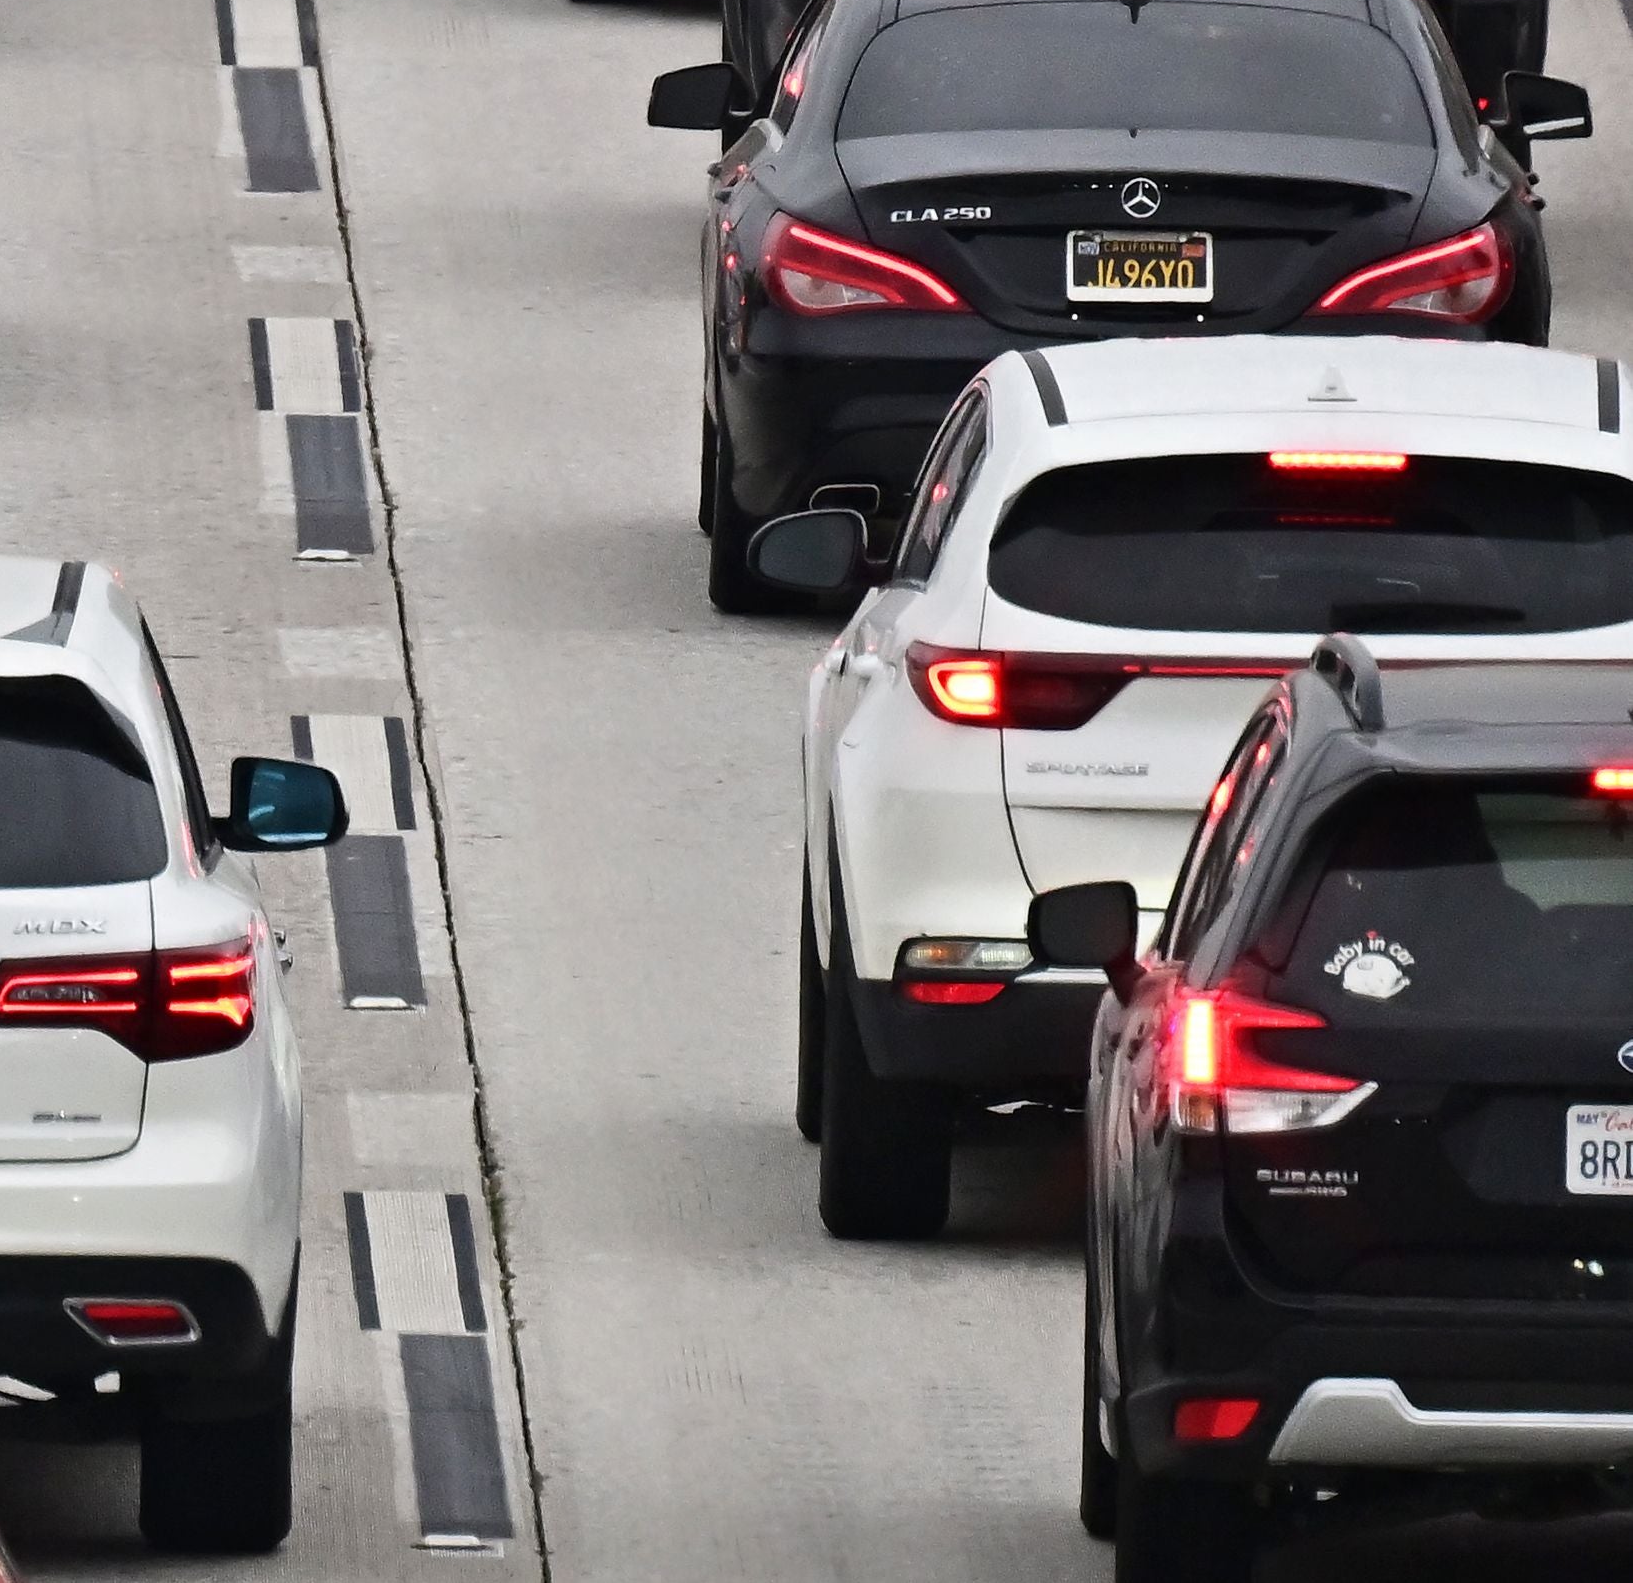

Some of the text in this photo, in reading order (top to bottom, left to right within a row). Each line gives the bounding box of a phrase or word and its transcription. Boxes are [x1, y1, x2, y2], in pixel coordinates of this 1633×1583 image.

[891, 207, 992, 223] CLA 250
[1103, 241, 1178, 253] CALIFORNIA
[1324, 930, 1415, 975] Baby in car
[1256, 1169, 1359, 1184] SUBARU
